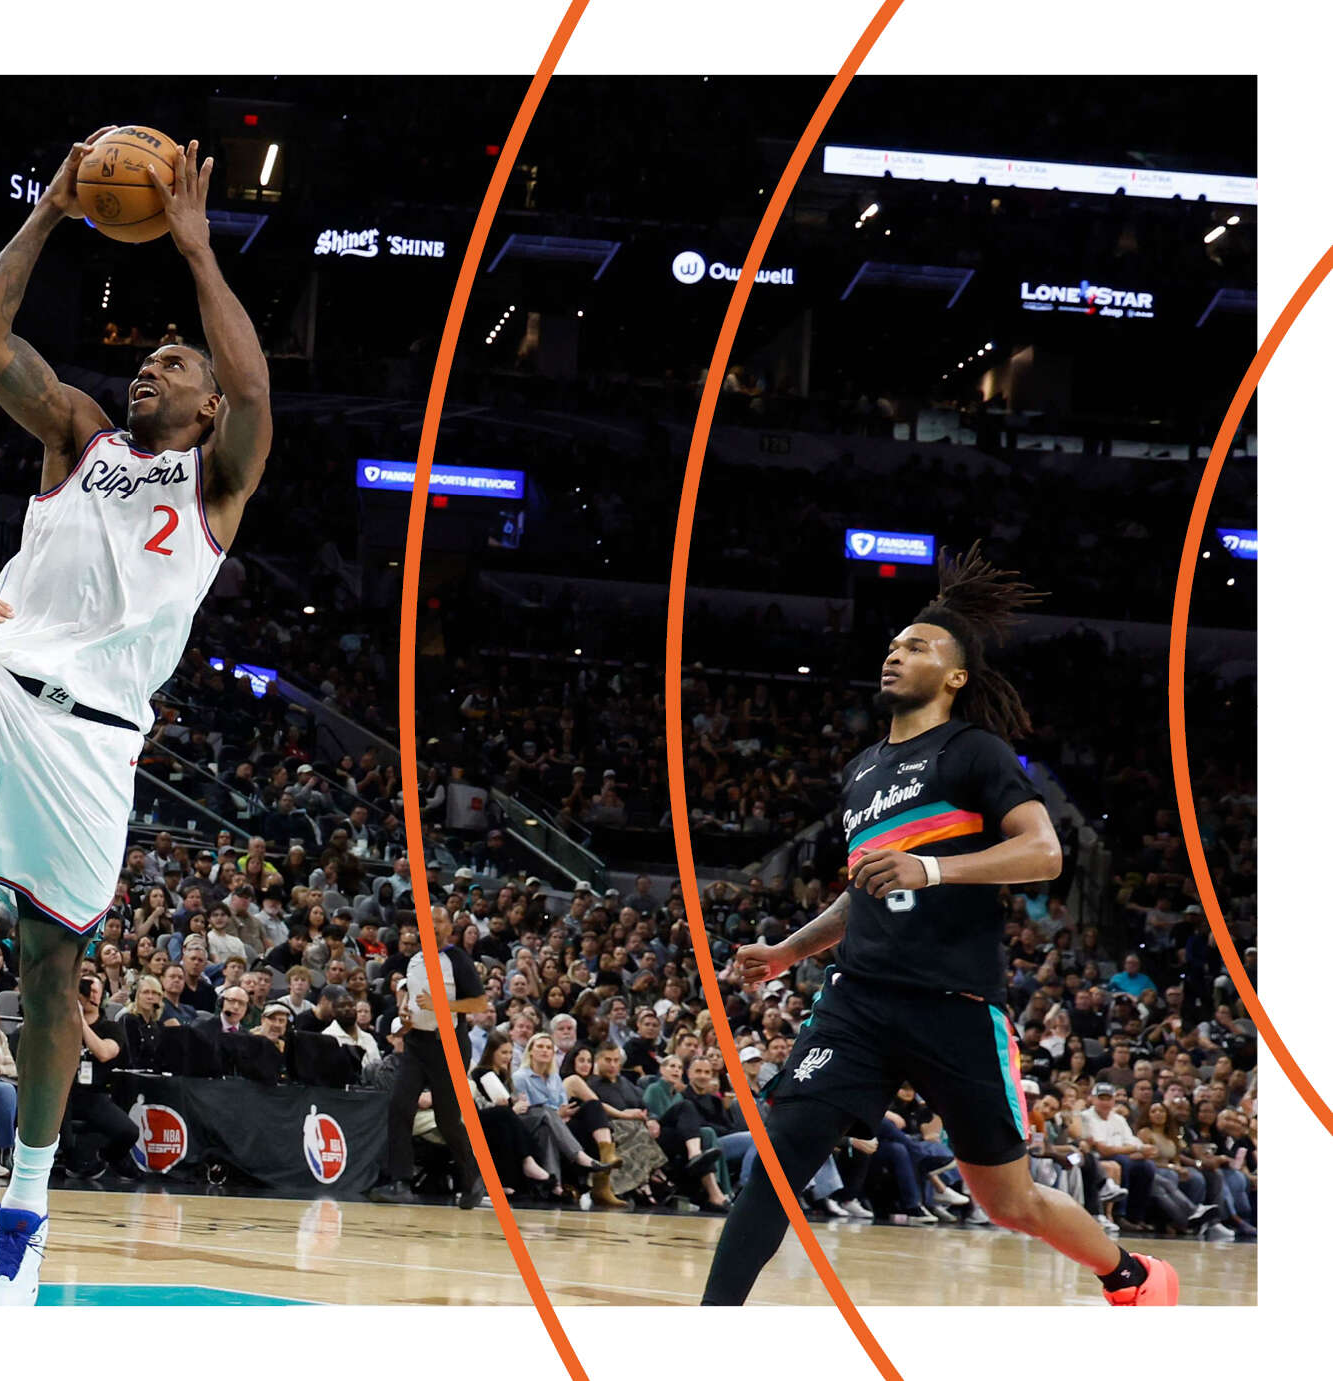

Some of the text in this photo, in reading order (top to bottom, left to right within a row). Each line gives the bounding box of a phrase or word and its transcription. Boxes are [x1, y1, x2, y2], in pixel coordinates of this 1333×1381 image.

[10, 174, 49, 205] SH
[314, 228, 379, 257] Shiner
[708, 262, 794, 285] Owwell
[1020, 281, 1153, 309] LONE STAR
[380, 470, 416, 483] FANDU
[468, 477, 516, 491] NETWORK
[144, 505, 179, 556] 2
[864, 778, 924, 820] Antonio
[147, 1143, 181, 1154] ESPN
[163, 1129, 181, 1143] NBA
